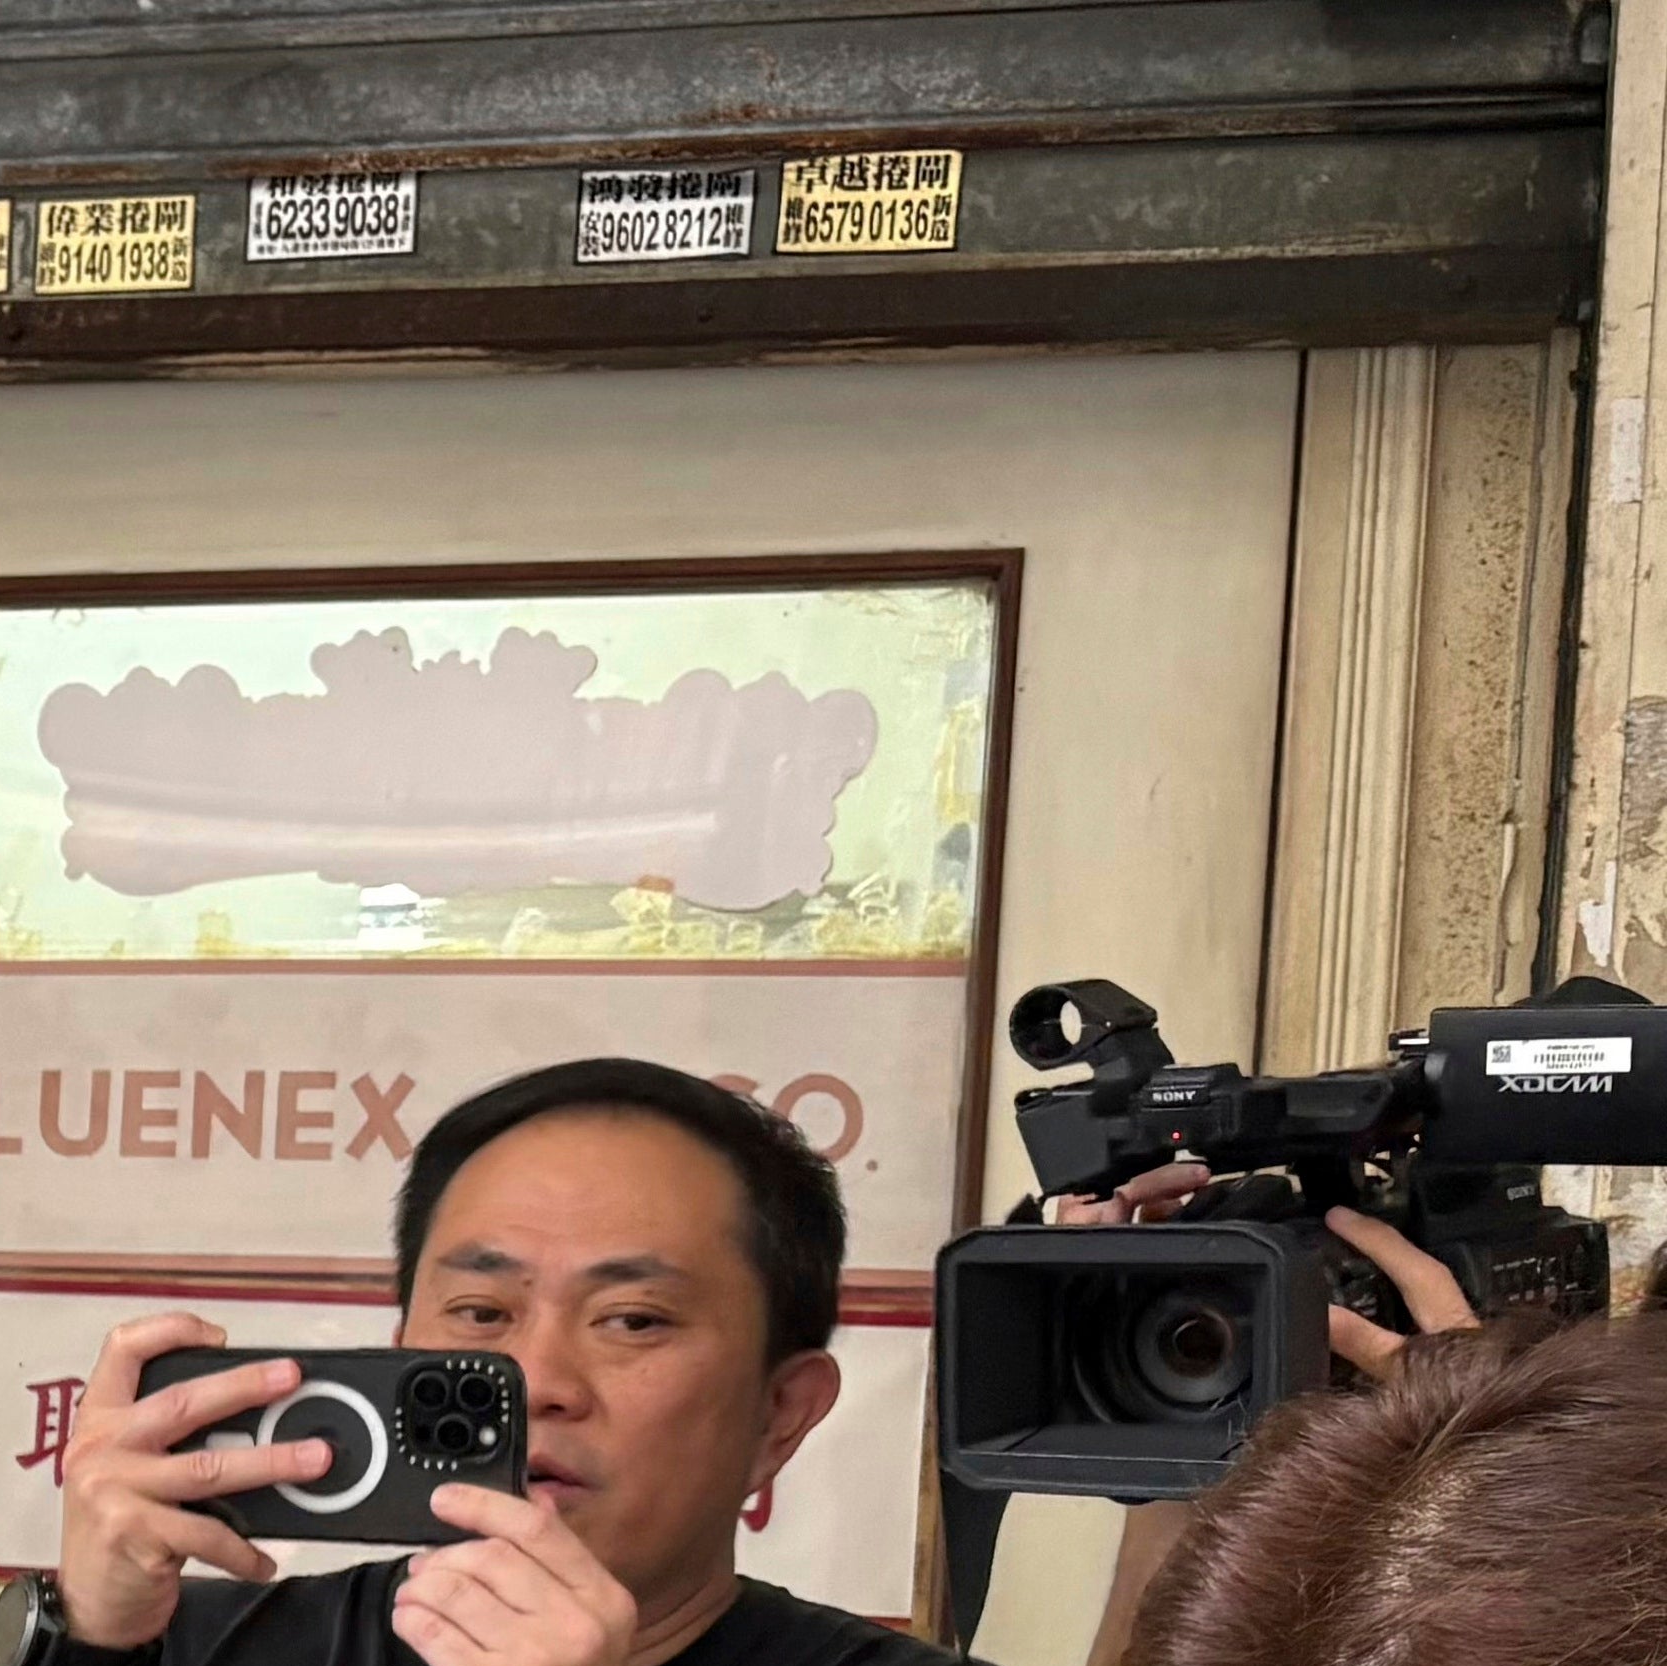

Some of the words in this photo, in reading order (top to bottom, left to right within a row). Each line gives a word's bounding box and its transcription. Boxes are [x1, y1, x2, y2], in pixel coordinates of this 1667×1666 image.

[796, 154, 951, 193] 卓越捲閘
[267, 199, 330, 240] 6233
[334, 193, 399, 238] 9038
[601, 212, 659, 251] 9602
[663, 206, 723, 249] 8212
[804, 200, 863, 243] 6579
[869, 199, 930, 241] 0136
[58, 242, 112, 284] 9140
[117, 240, 169, 282] 1938
[1152, 1090, 1197, 1103] SONY
[1498, 1074, 1613, 1093] XDCAM
